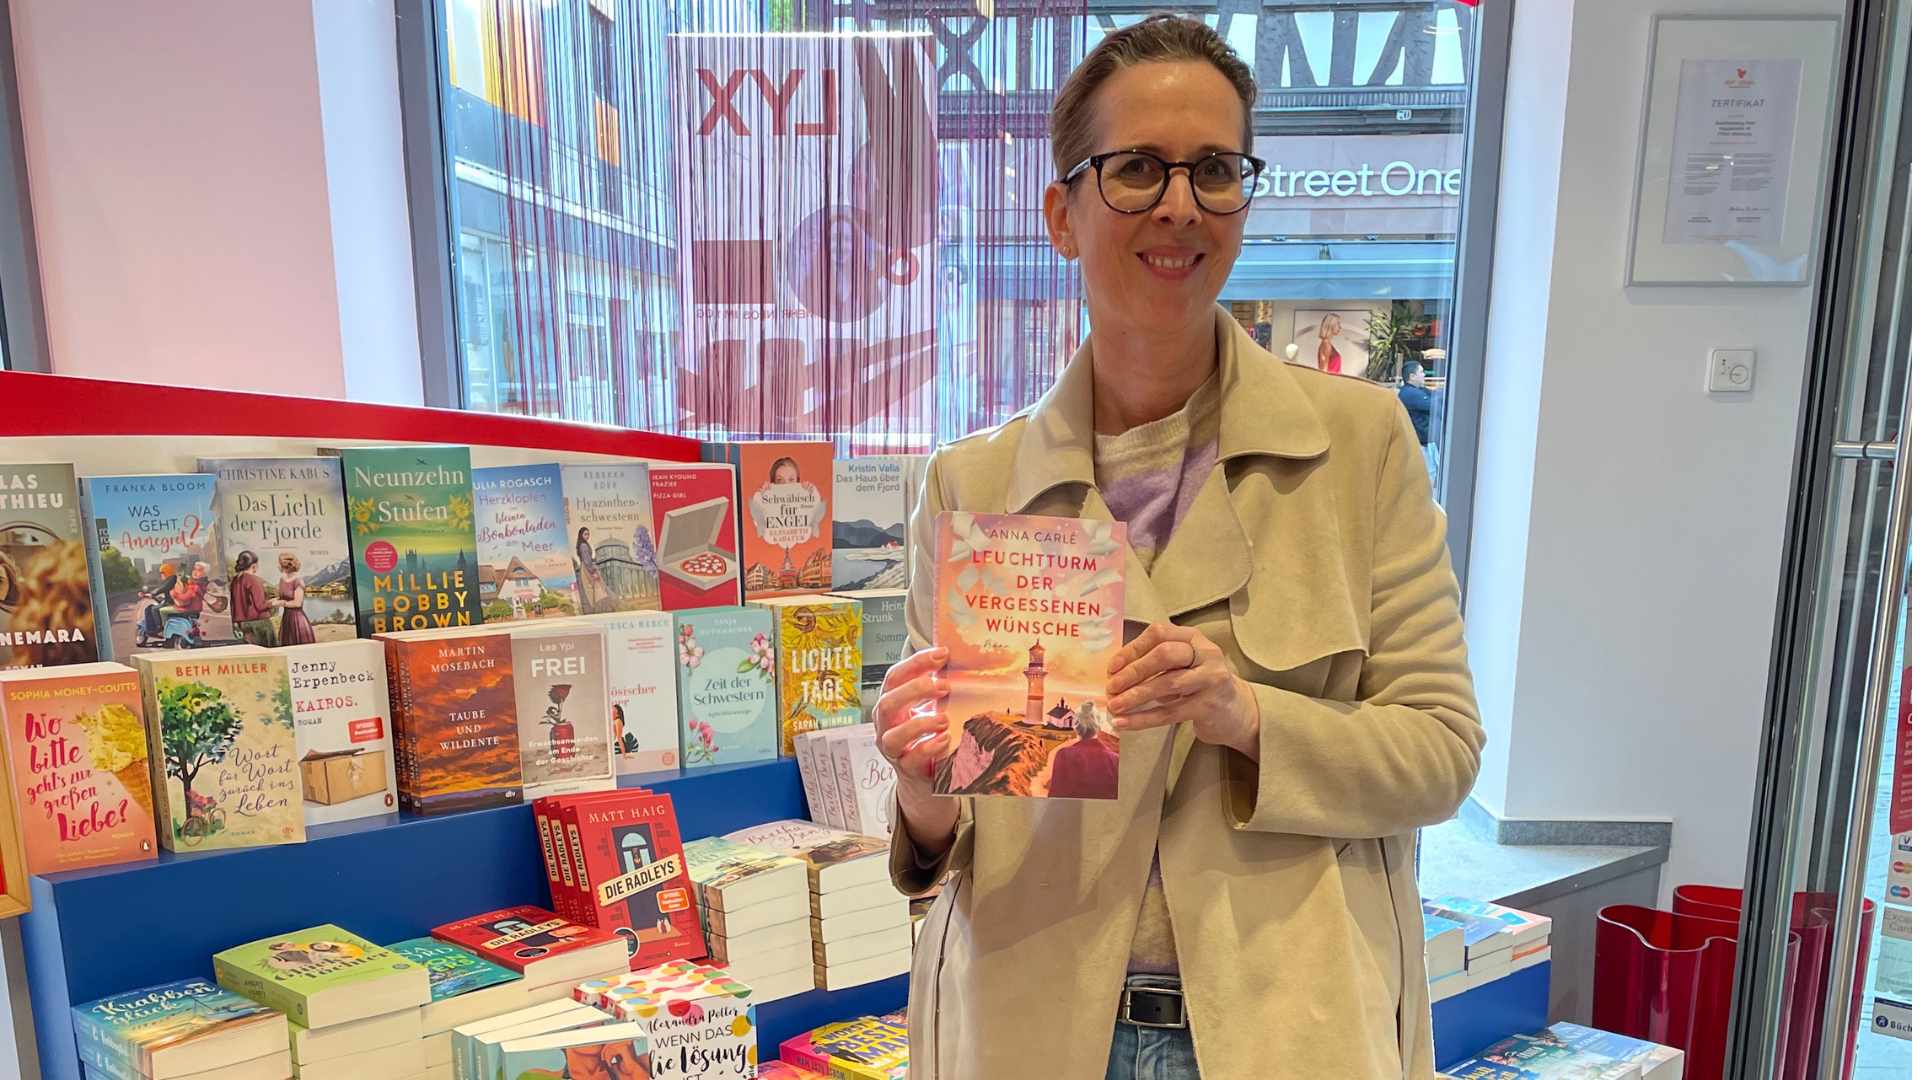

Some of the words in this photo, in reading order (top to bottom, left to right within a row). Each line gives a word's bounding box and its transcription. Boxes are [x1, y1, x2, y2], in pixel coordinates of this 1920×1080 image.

[1711, 98, 1766, 109] ZERTIFIKAT
[1254, 163, 1374, 198] Street
[1381, 161, 1460, 196] One
[218, 470, 287, 482] CHRISTINE
[289, 468, 330, 479] KABUS
[353, 466, 465, 488] Neunzehn
[836, 474, 854, 483] Das
[856, 473, 878, 482] Haus
[879, 472, 900, 482] über
[848, 463, 877, 473] Kristin
[105, 484, 156, 496] FRANKA
[161, 481, 206, 492] BLOOM
[499, 477, 552, 489] ROGASCH
[856, 482, 875, 492] dem
[877, 482, 900, 493] Fjord
[128, 504, 161, 518] WAS
[238, 496, 269, 513] Das
[271, 494, 327, 518] Licht
[377, 498, 449, 524] Stufen
[579, 508, 640, 523] schwestern
[780, 503, 798, 516] für
[230, 515, 257, 532] der
[260, 519, 322, 546] Fjorde
[477, 515, 558, 543] Bonbonladen
[766, 514, 812, 529] ENGEL
[521, 541, 554, 553] Meer
[990, 529, 1029, 543] ANNA
[1033, 531, 1077, 545] CARLÉ
[971, 550, 1098, 571] LEUCHTTURM
[373, 570, 465, 594] MILLIE
[1016, 575, 1053, 591] DER
[372, 590, 468, 613] BOBBY
[965, 594, 1101, 616] VERGESSENEN
[373, 610, 471, 634] BROWN
[862, 612, 895, 624] Strunk
[986, 615, 1080, 638] WÜNSCHE
[438, 645, 486, 657] MARTIN
[540, 643, 558, 652] Lea
[559, 641, 575, 652] Ypi
[175, 665, 212, 677] BETH
[217, 663, 269, 674] MILLER
[290, 660, 337, 676] Jenny
[431, 658, 496, 674] MOSEBACH
[531, 656, 586, 678] FREI
[791, 646, 855, 673] LICHTE
[293, 671, 376, 690] Erpenbeck
[704, 678, 728, 691] Zeit
[731, 676, 752, 688] der
[799, 679, 845, 703] TAGE
[10, 689, 50, 702] SOPHIA
[54, 681, 138, 698] MONEY-COUTTS
[693, 690, 765, 706] Schwestern
[448, 709, 487, 722] TAUBE
[24, 711, 62, 744] Wo
[455, 723, 482, 736] UND
[439, 735, 501, 753] WILDENTE
[30, 736, 84, 775] bitte
[229, 743, 281, 768] Wort
[69, 768, 94, 789] zur
[218, 765, 239, 785] für
[241, 761, 292, 782] Wort
[218, 778, 265, 802] zurück
[44, 784, 97, 819] großen
[233, 796, 289, 817] Leben
[56, 797, 130, 843] Liebe?
[588, 810, 625, 825] MATT
[632, 805, 665, 818] HAIG
[541, 820, 555, 863] RADLEYS
[554, 824, 568, 865] RADLEYS
[570, 829, 583, 870] RADLEYS
[605, 880, 625, 900] DIE
[626, 861, 675, 892] RADLEYS
[489, 935, 508, 947] DIE
[708, 1007, 739, 1024] Potter
[655, 1031, 701, 1049] WENN
[705, 1024, 734, 1041] DAS
[823, 1022, 868, 1041] WORST
[844, 1026, 897, 1049] BEST
